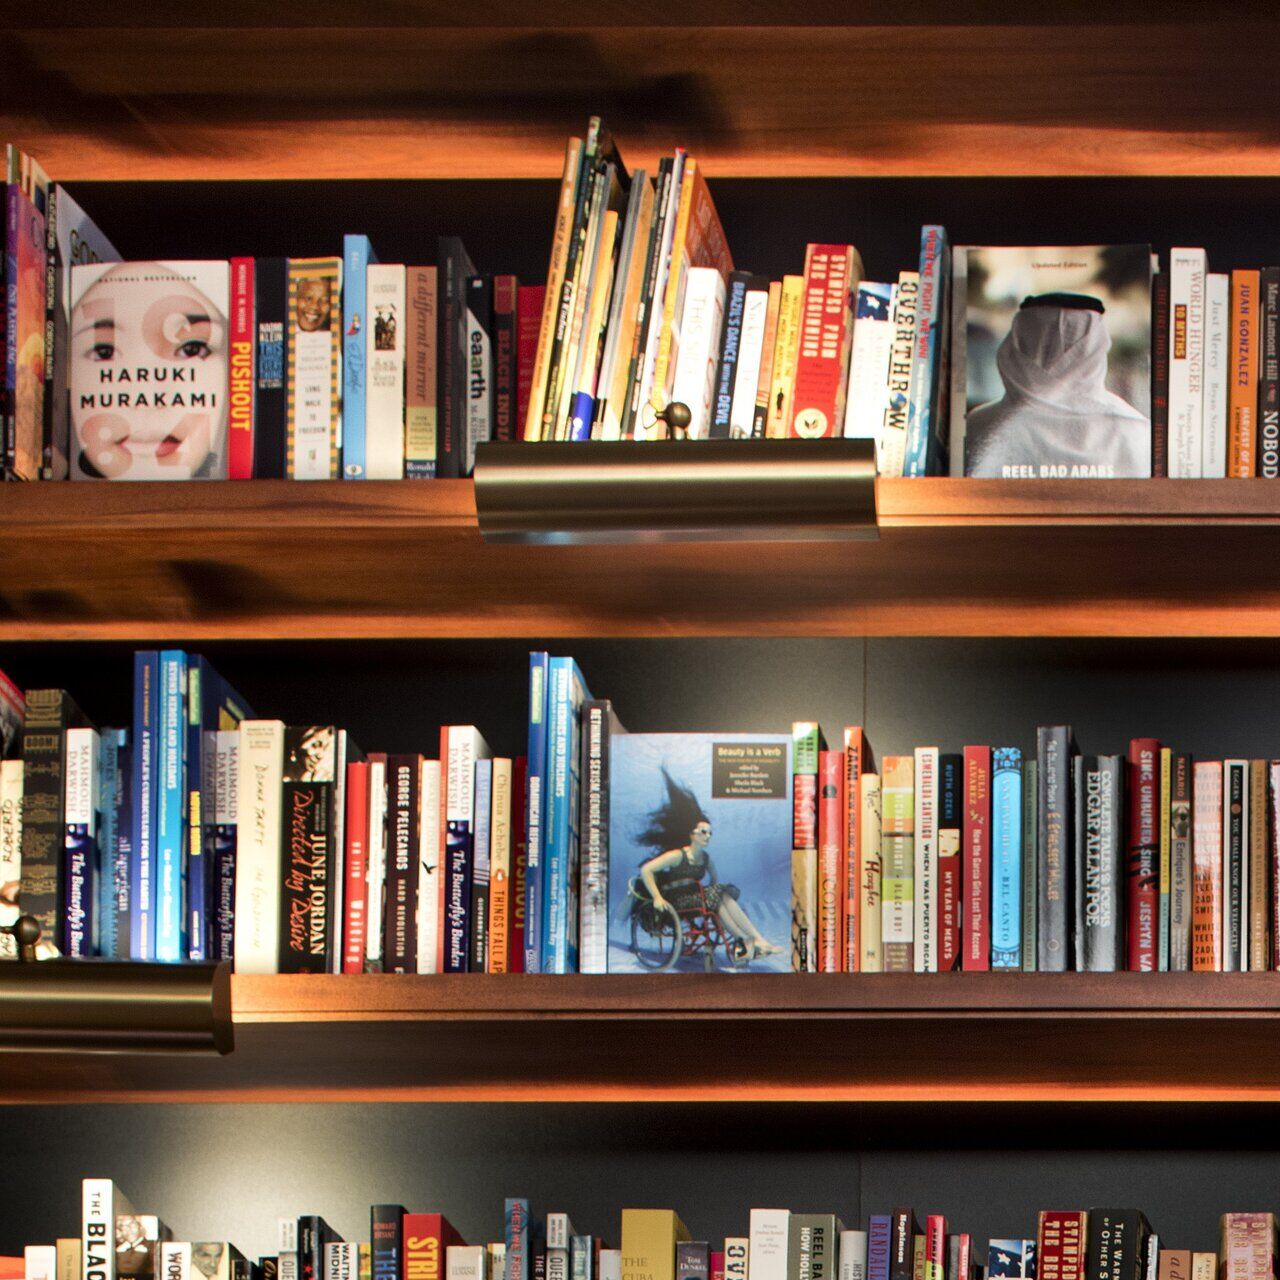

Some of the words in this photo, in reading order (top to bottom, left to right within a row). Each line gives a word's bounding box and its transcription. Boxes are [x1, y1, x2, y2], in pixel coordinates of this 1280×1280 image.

[100, 368, 196, 384] HARUKI
[231, 342, 251, 431] PUSHOUT
[81, 393, 216, 408] MURAKAMI
[1001, 465, 1033, 478] REEL
[1038, 465, 1065, 478] BAD
[1068, 465, 1113, 478] ARABS
[310, 834, 326, 880] JUNE
[310, 885, 326, 954] JORDAN
[92, 1192, 100, 1215] THE
[812, 1228, 824, 1259] REEL
